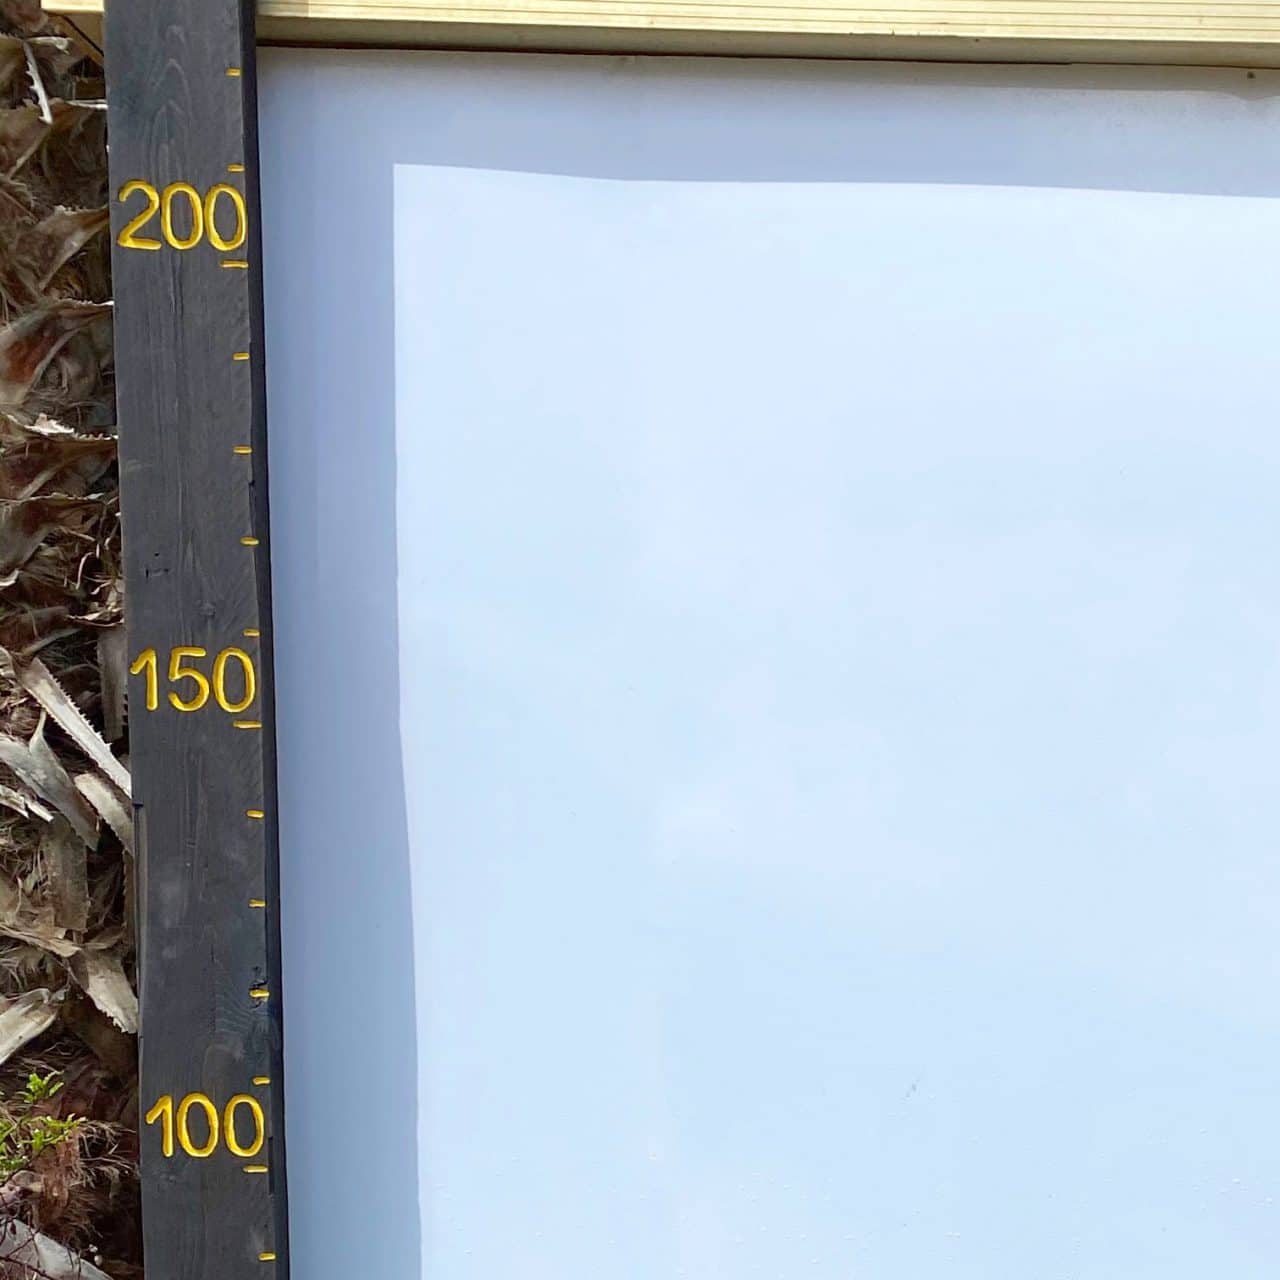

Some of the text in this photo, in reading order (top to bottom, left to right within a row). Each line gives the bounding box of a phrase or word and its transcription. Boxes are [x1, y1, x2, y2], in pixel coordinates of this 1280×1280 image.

[117, 179, 248, 251] 200
[130, 647, 256, 713] 150
[146, 1091, 265, 1158] 100
